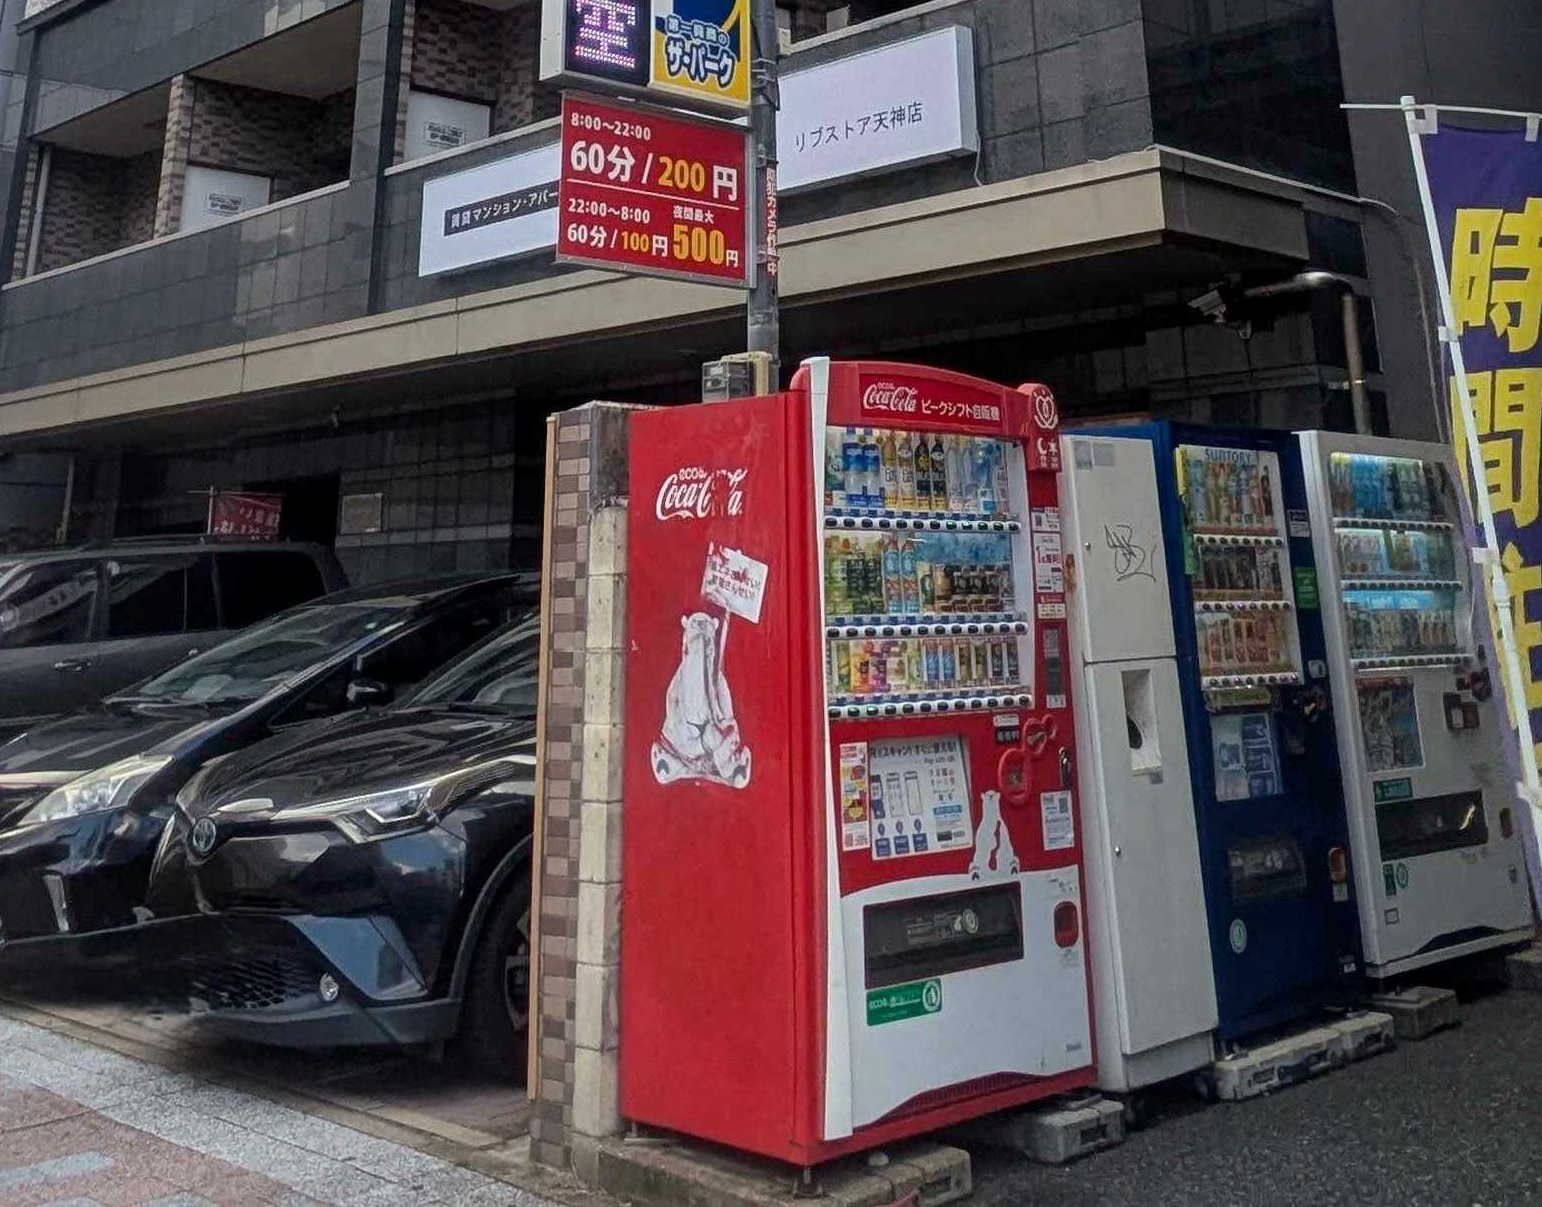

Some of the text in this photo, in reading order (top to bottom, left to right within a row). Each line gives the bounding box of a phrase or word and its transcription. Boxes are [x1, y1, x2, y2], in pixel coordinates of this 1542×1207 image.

[666, 38, 734, 86] ザ・パーク
[794, 100, 923, 153] リブストア天神店
[673, 205, 715, 224] 夜間最大
[921, 398, 1001, 422] ピークシフト自販機
[1205, 447, 1252, 465] SUNTORY
